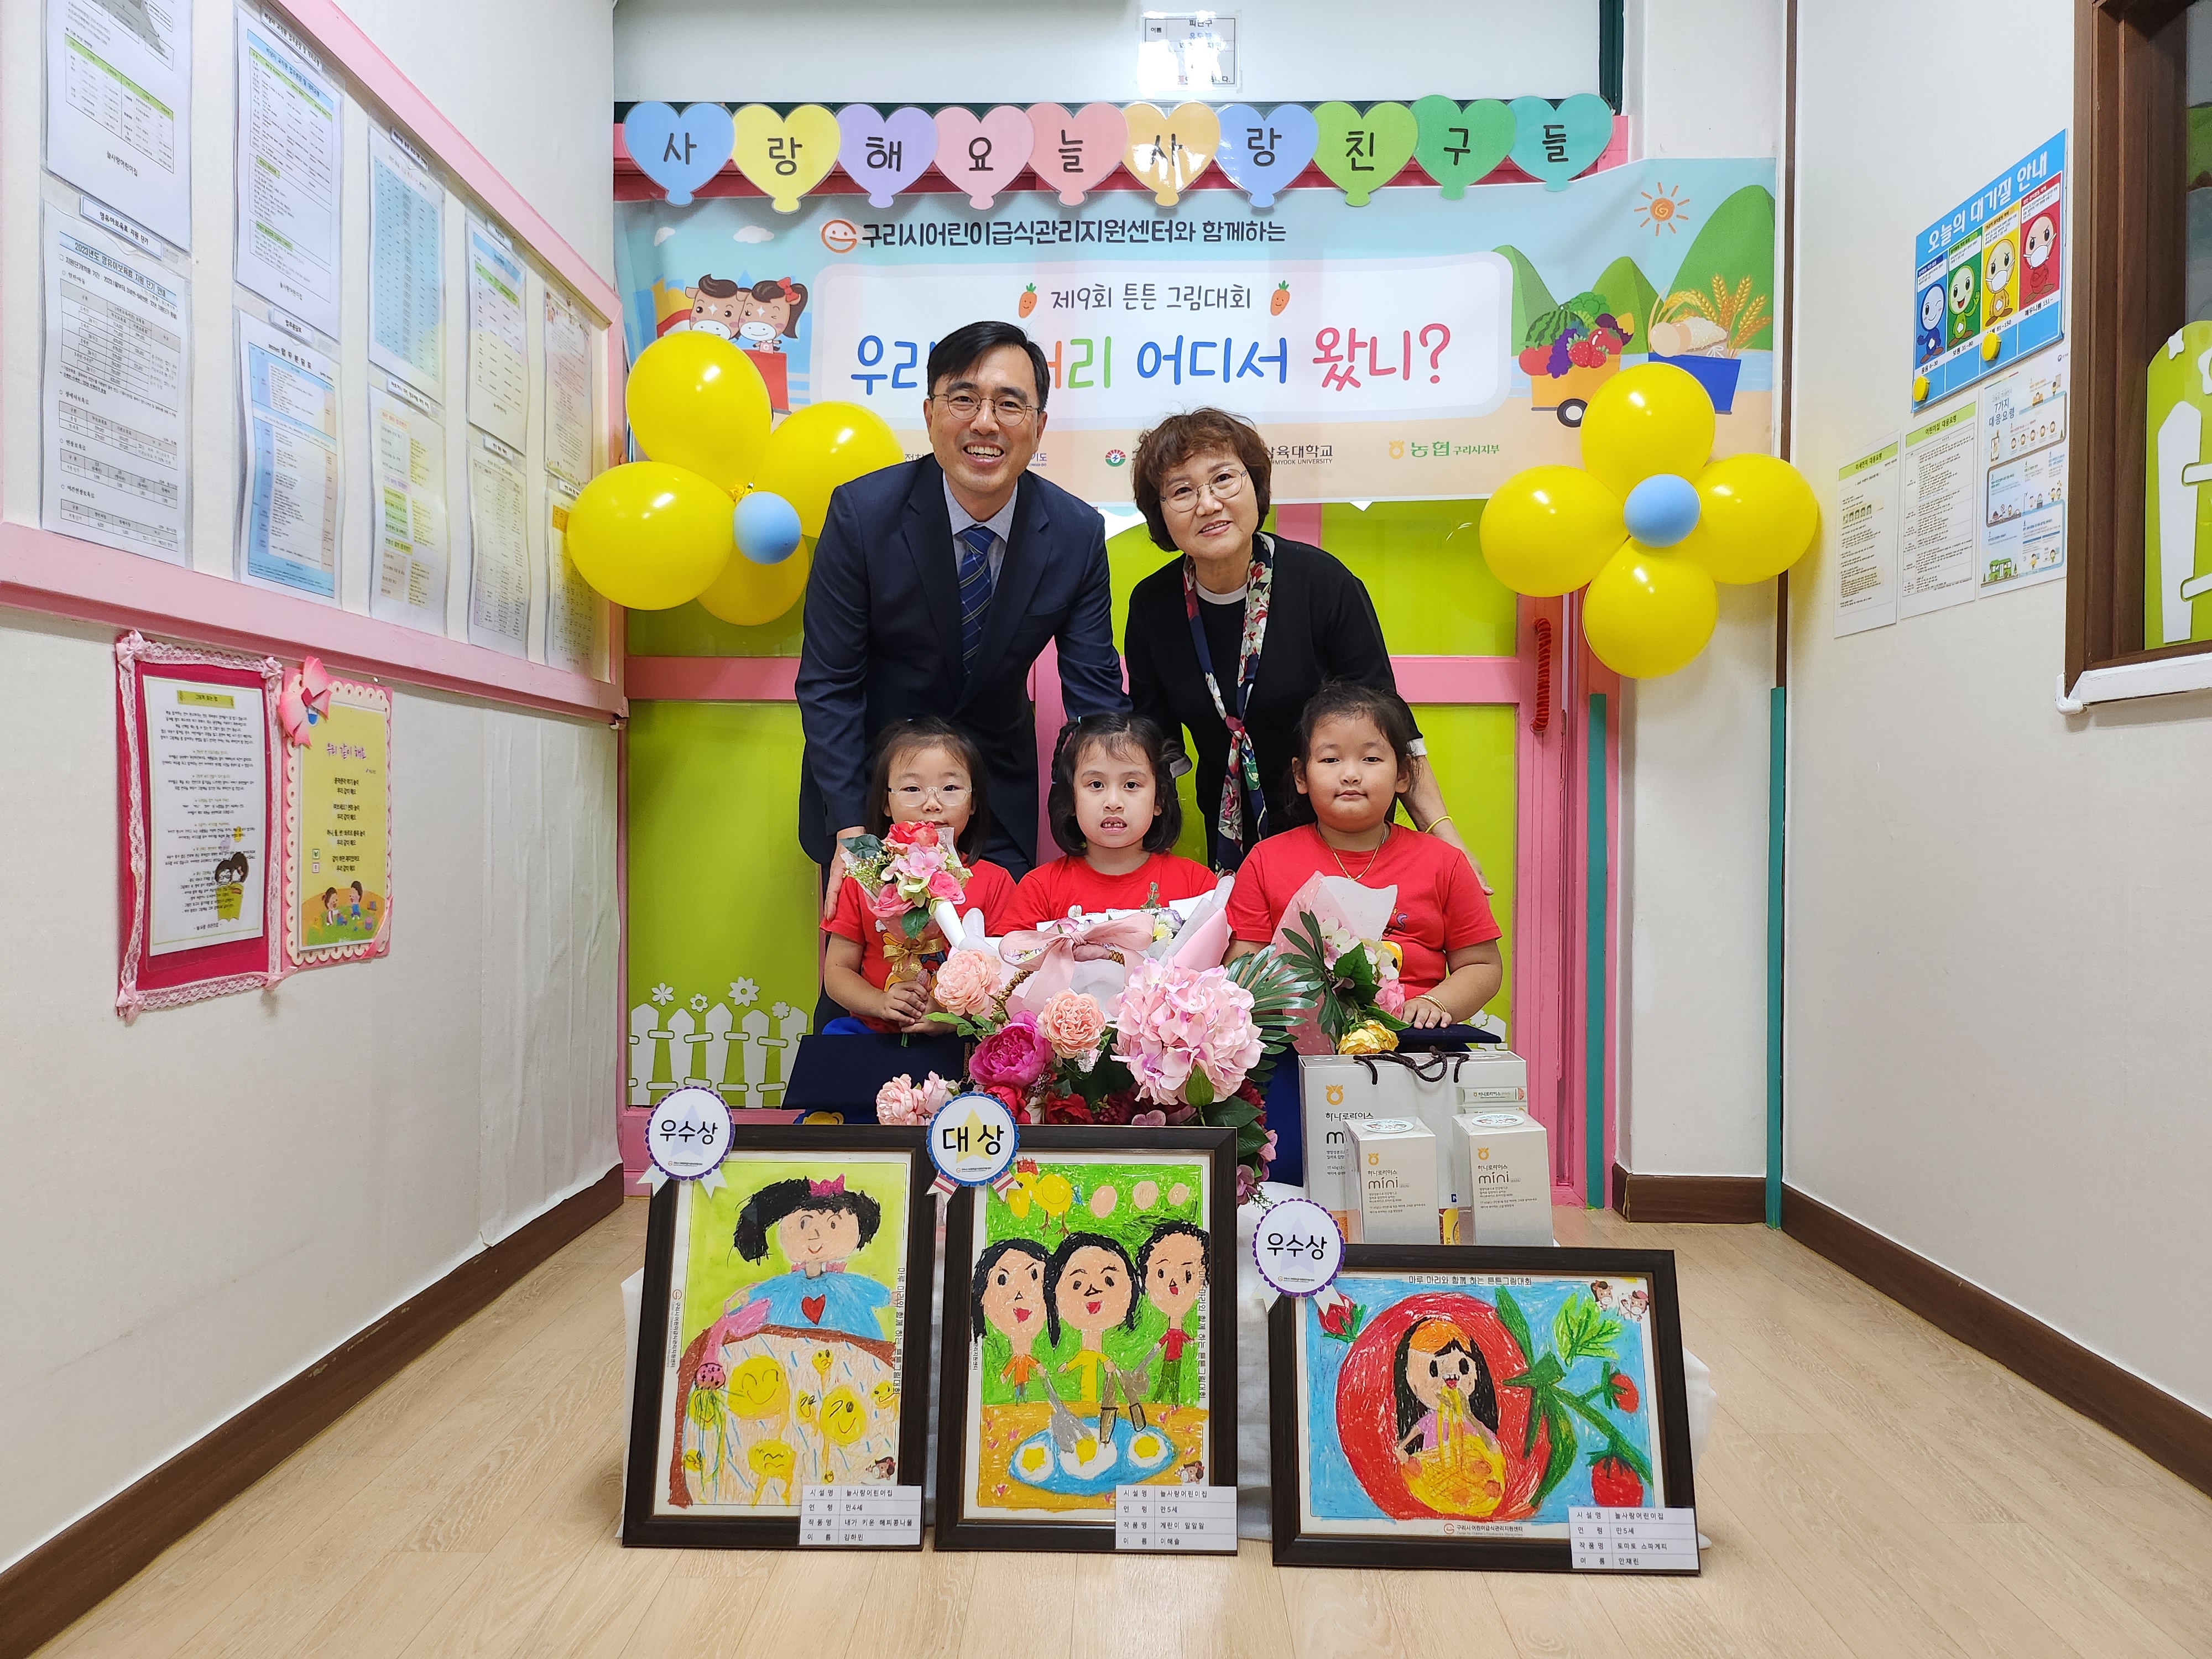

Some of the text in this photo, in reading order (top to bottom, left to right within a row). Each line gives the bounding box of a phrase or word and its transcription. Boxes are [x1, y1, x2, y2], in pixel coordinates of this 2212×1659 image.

[107, 150, 138, 177] 늘사랑어린이집
[1928, 210, 1965, 253] 오늘의
[1970, 176, 2012, 223] 대기질
[2017, 151, 2048, 192] 안내
[100, 211, 149, 246] 영유아보육료 지원 단가
[862, 220, 1287, 248] 구리시어린이급식관리지원센터와 함께하는
[75, 242, 100, 262] 2023년도
[102, 256, 133, 278] 영유아보육료
[135, 273, 144, 285] 지원
[1050, 283, 1251, 311] 제9회 튼튼 그림대회
[1137, 335, 1287, 385] 어디서
[1312, 323, 1451, 392] 왔니?
[1994, 397, 2010, 413] 7가지
[1989, 406, 2015, 427] 대응요령
[1925, 415, 1957, 436] 어린이집 대응요령
[1411, 441, 1500, 458] 농협 구리시지부
[1855, 452, 1882, 470] 미세먼지 대응요령
[326, 743, 367, 759] 우리 같이 해요
[1325, 1112, 1374, 1121] 하나로라이스
[660, 1120, 718, 1145] 우수상
[943, 1124, 1005, 1155] 대상
[1368, 1176, 1399, 1190] mini
[1478, 1171, 1509, 1184] mini
[1266, 1233, 1328, 1260] 우수상
[1408, 1275, 1532, 1286] 마루 마리와 함께 하는 튼튼그림대회
[1198, 1289, 1206, 1312] 마리와
[895, 1311, 904, 1326] 함께
[1198, 1315, 1206, 1330] 함께
[895, 1330, 902, 1345] 하는
[1198, 1333, 1206, 1349] 하는
[846, 1489, 893, 1497] 늘사랑어린이집
[1124, 1489, 1208, 1498] 시설명 늘사랑어린이집
[1615, 1512, 1664, 1520] 늘사랑어린이집
[1618, 1557, 1639, 1566] 안채린
